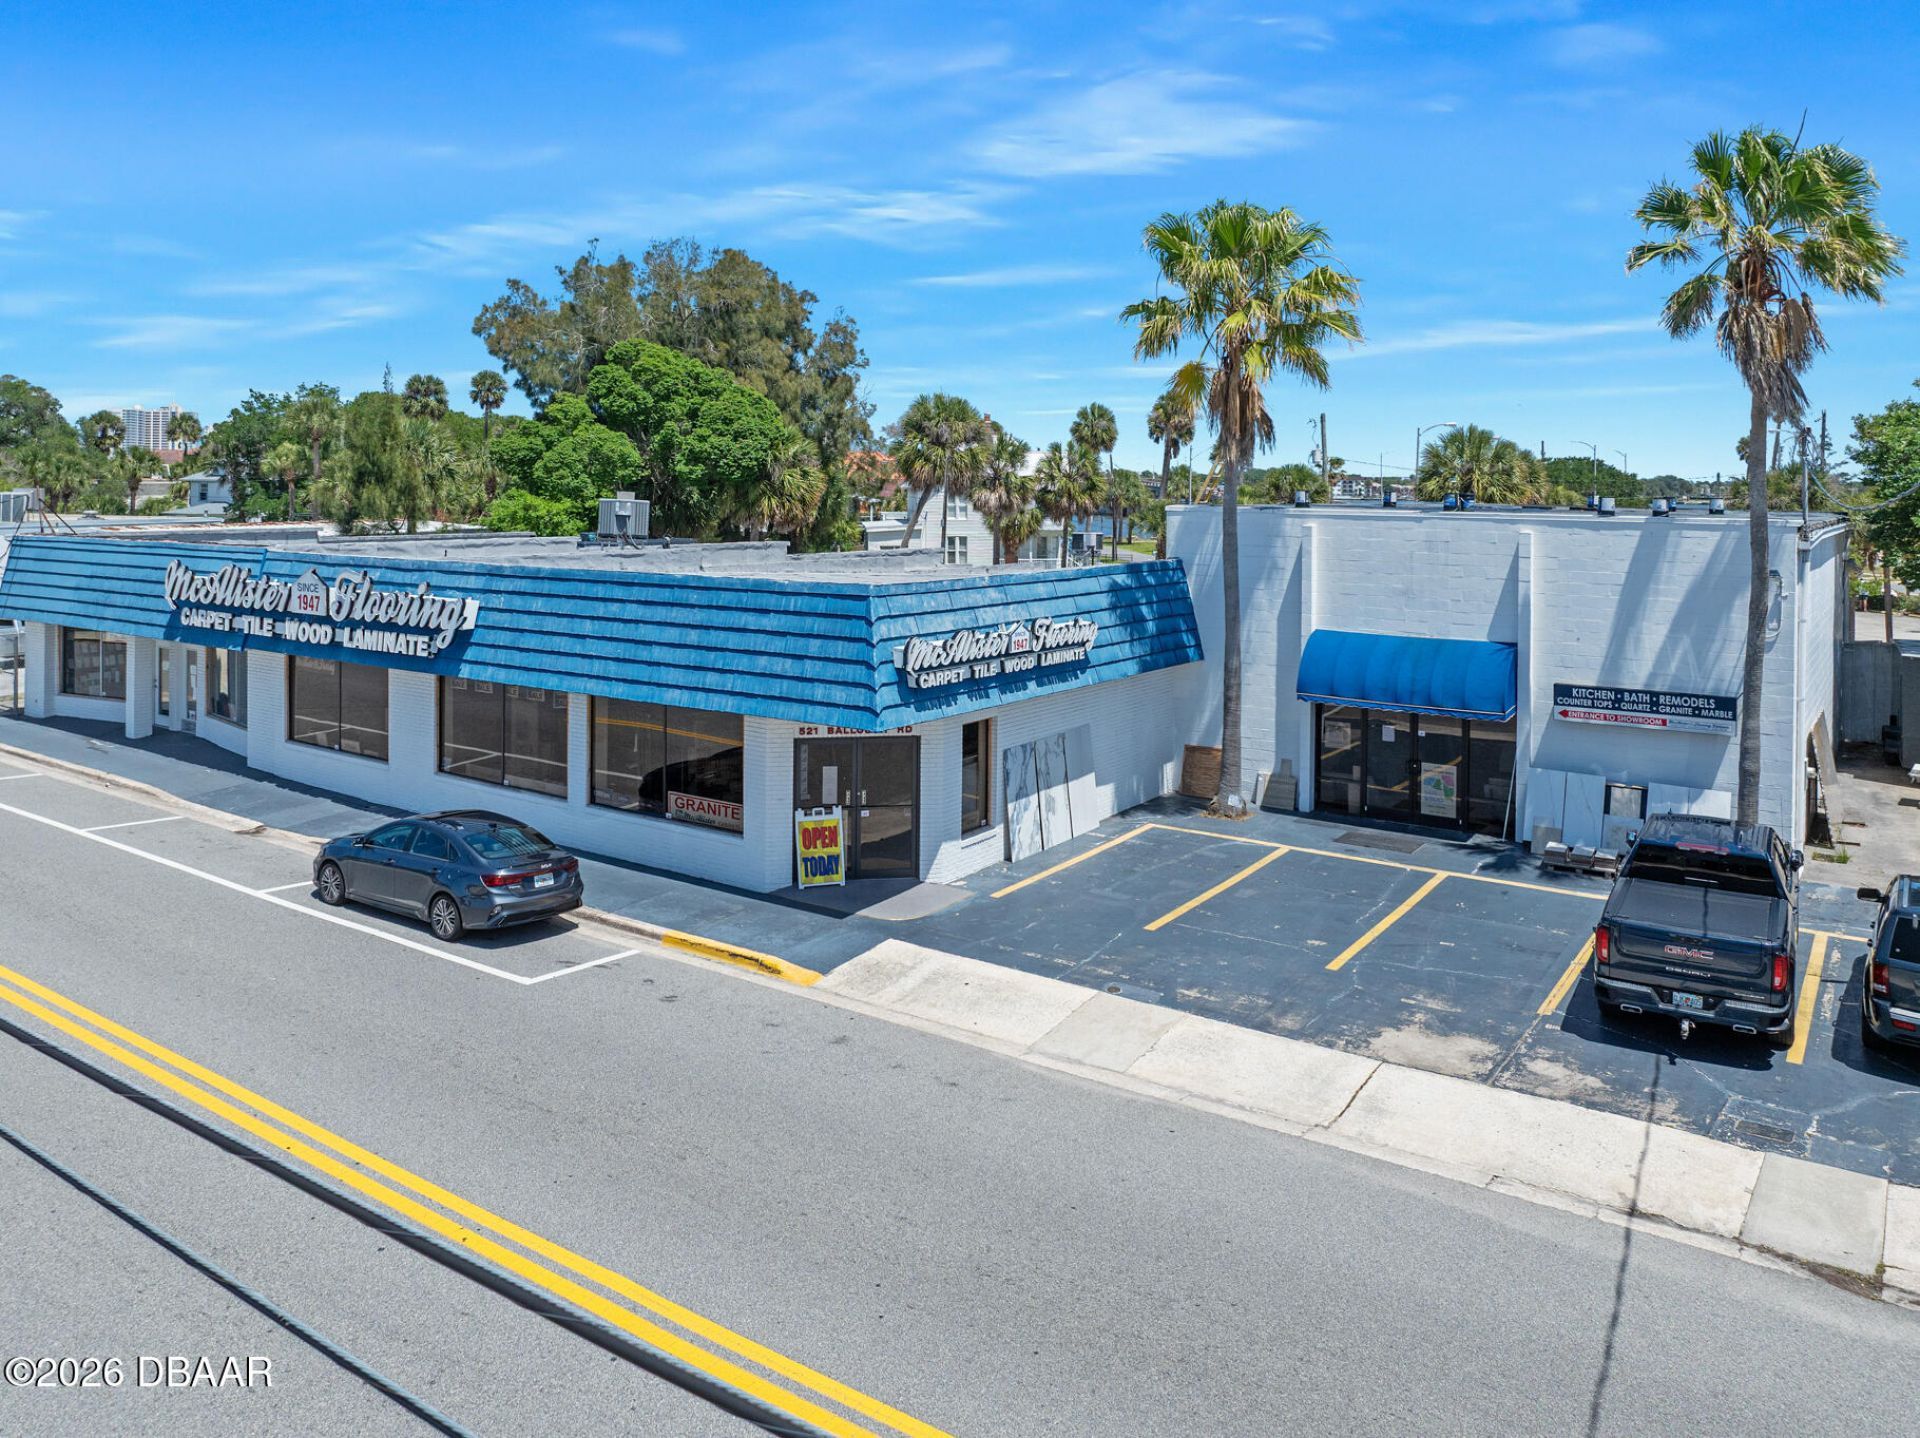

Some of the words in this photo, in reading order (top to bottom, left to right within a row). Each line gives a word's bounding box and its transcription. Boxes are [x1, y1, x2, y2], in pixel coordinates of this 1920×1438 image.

[297, 582, 319, 594] SINCE
[165, 559, 291, 612] McAllister
[329, 569, 468, 649] Flooring
[297, 594, 320, 612] 1947
[181, 606, 233, 632] CARPET
[242, 614, 274, 637] TILE
[284, 619, 333, 645] WOOD
[343, 626, 430, 657] LAMINATE
[903, 629, 1009, 677] McAllister
[1031, 616, 1098, 651] Flooring
[1013, 638, 1028, 650] 1947
[918, 669, 965, 688] CARPET
[973, 664, 998, 679] TILE
[1002, 657, 1035, 673] WOOD
[1040, 649, 1086, 666] LAMINATE
[1557, 696, 1592, 707] COUNTER
[1593, 699, 1613, 709] TOPS
[1620, 702, 1651, 712] QUARTZ
[1658, 705, 1693, 716] GRANITE
[1701, 709, 1733, 719] MARBLE
[1572, 687, 1615, 700] KITCHEN
[1623, 692, 1650, 703] BATH
[1659, 695, 1716, 708] REMODELS
[1568, 710, 1606, 721] ENTRANCE
[1606, 713, 1616, 722] TO
[1617, 715, 1663, 726] SHOWROOM
[799, 727, 818, 735] 521
[674, 796, 741, 820] GRANITE
[801, 826, 839, 850] OPEN
[802, 854, 840, 878] TODAY
[1664, 944, 1714, 960] GMC
